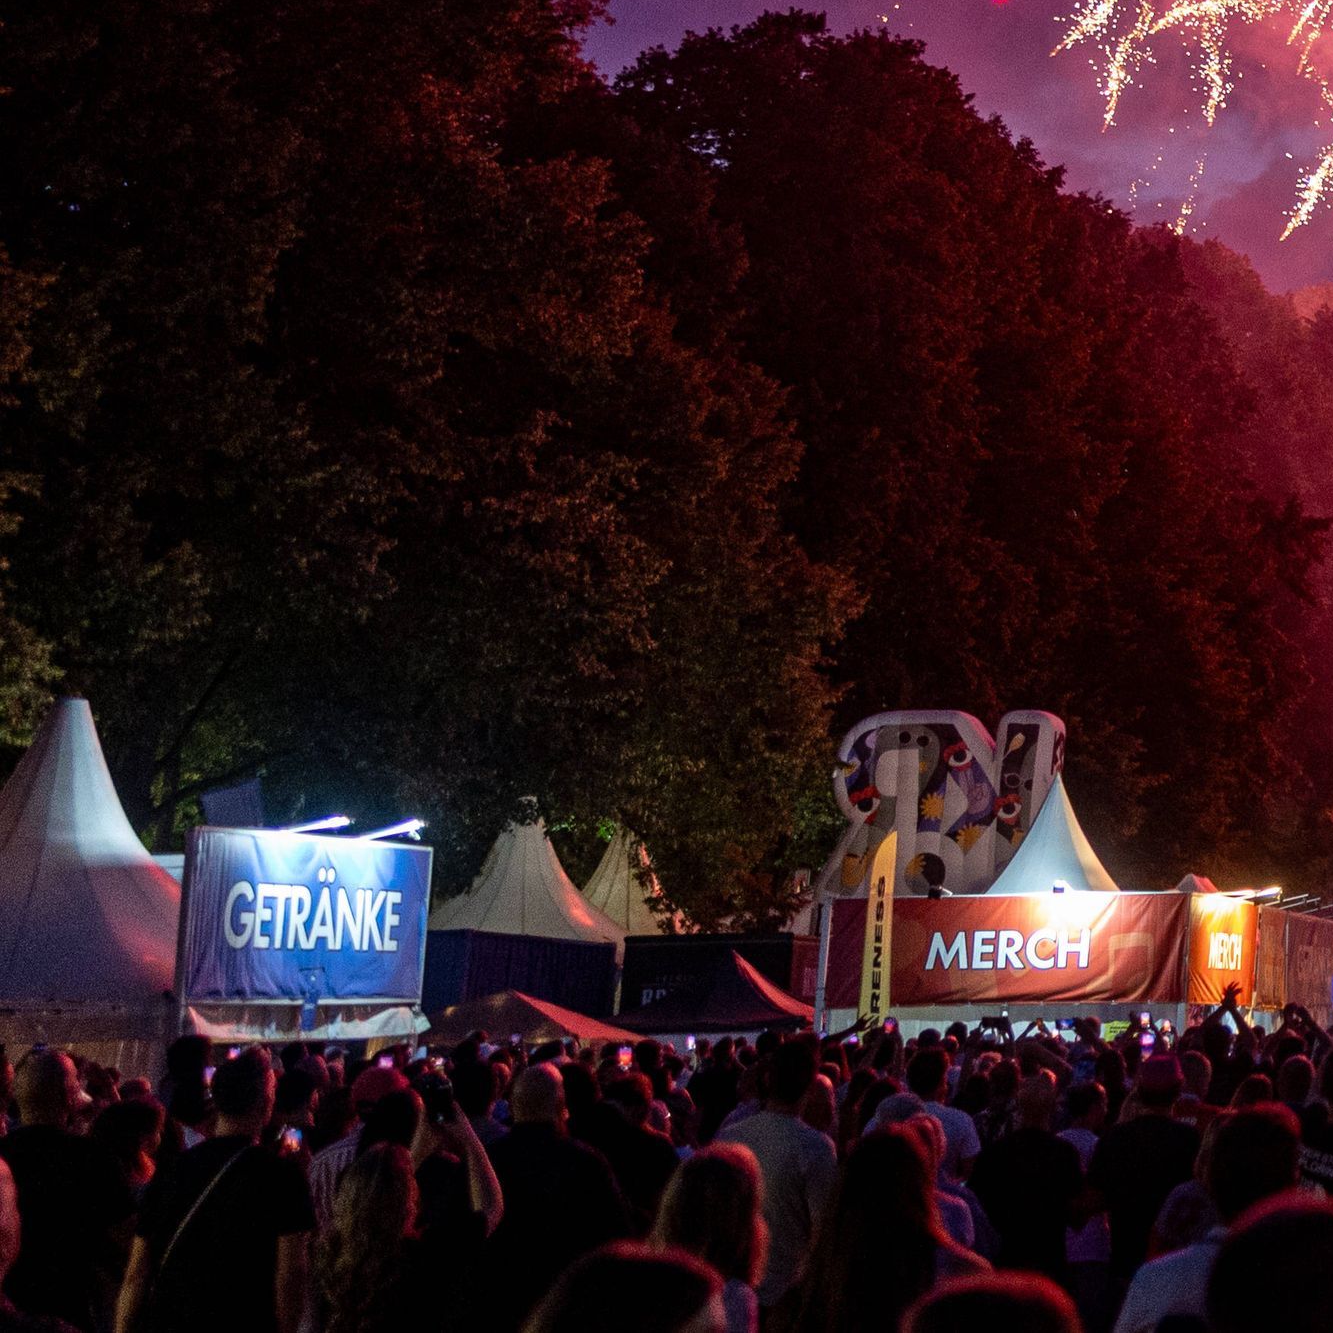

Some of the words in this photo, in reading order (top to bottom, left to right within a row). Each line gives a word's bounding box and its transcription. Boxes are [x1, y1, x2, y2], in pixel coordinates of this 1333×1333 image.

[223, 866, 402, 952] GETRÄNKE
[869, 875, 886, 1014] RENESS
[924, 928, 1092, 971] MERCH
[1208, 931, 1242, 971] MERCH
